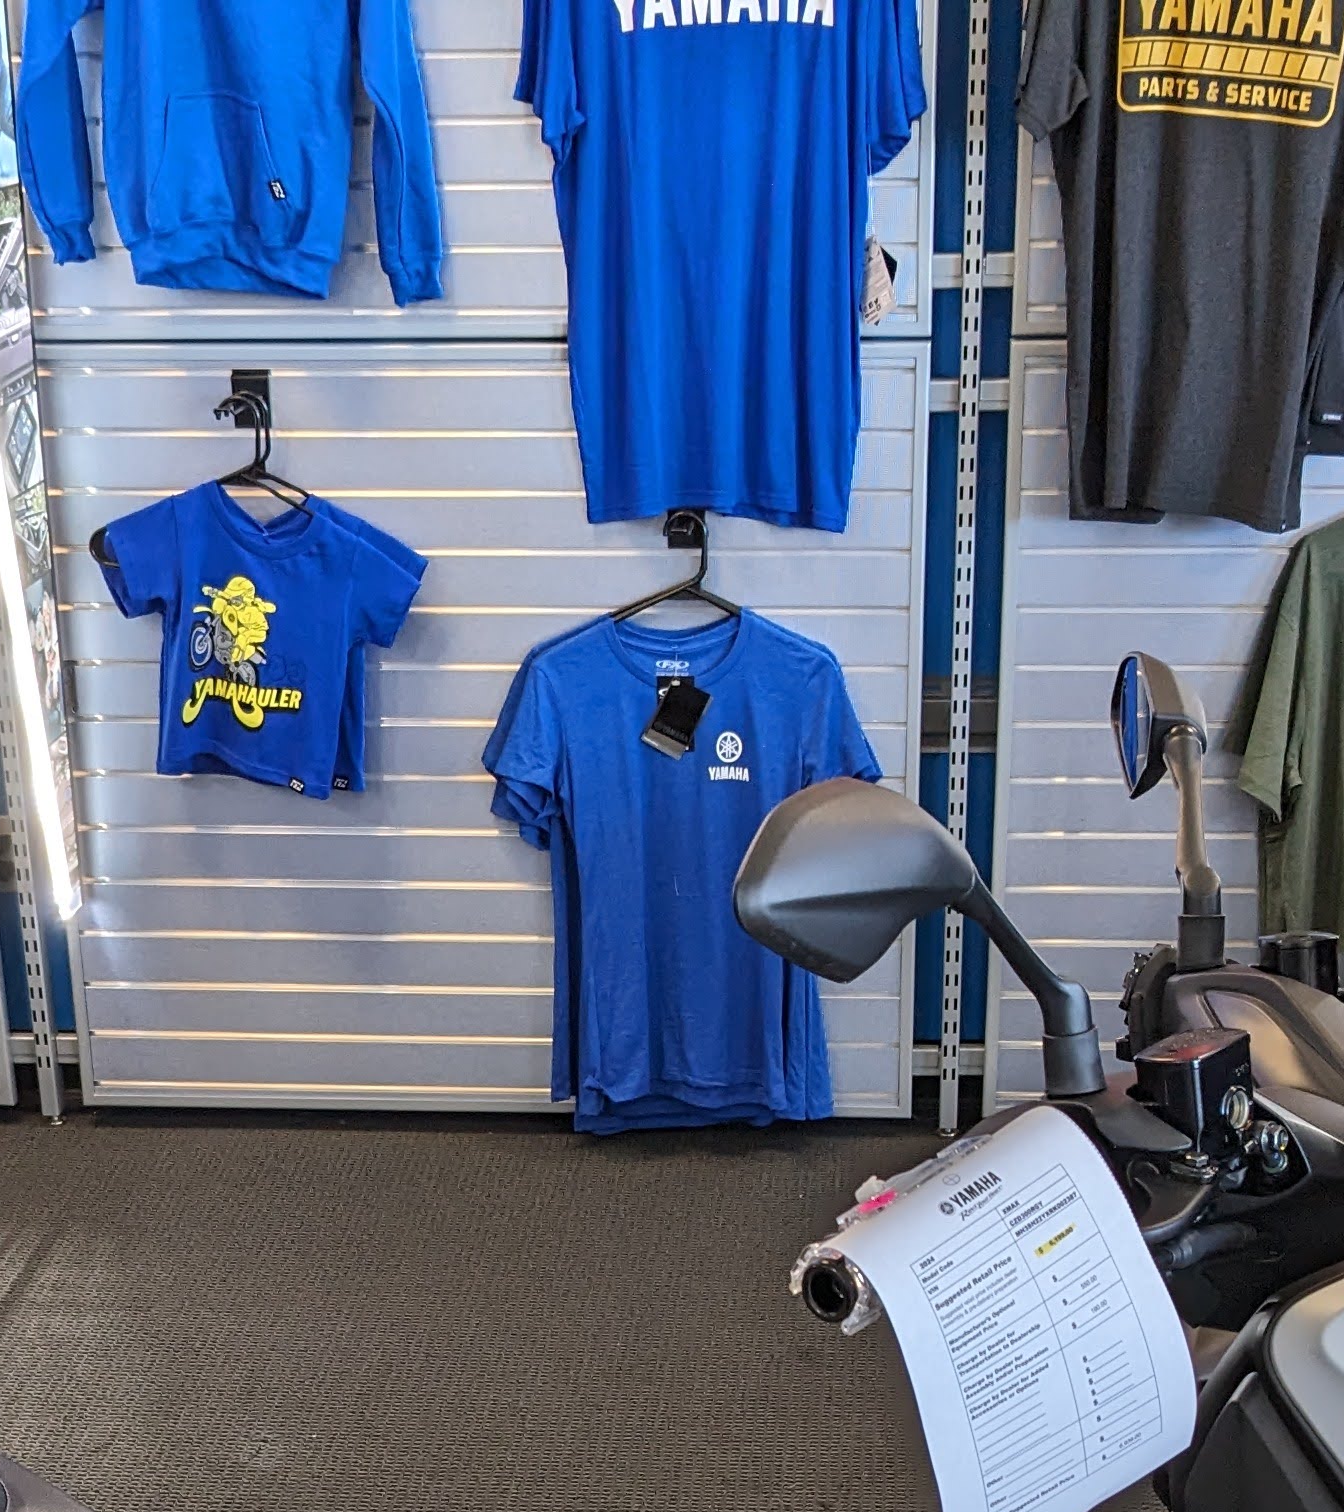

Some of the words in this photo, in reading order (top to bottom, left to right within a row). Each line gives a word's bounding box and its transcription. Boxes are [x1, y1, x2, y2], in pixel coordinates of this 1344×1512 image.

[1140, 0, 1332, 45] YAMAHA
[1139, 77, 1200, 100] PARTS
[1206, 81, 1219, 102] &
[1225, 83, 1312, 112] SERVICE
[708, 766, 750, 782] YAMAHA
[949, 1171, 1002, 1207] YAMAHA
[922, 1270, 939, 1284] Model
[939, 1260, 954, 1272] Code
[928, 1285, 939, 1296] VIN
[934, 1282, 972, 1311] Suggested
[972, 1268, 993, 1287] Retail
[993, 1256, 1012, 1271] Price
[949, 1316, 991, 1345] Manufacturer's
[992, 1299, 1016, 1318] Optional
[951, 1330, 982, 1353] Equipment
[983, 1321, 998, 1333] Price
[957, 1355, 978, 1370] Charge
[987, 1336, 1006, 1351] Dealer
[1007, 1330, 1015, 1338] for
[959, 1348, 1003, 1377] Transportation
[1010, 1323, 1041, 1345] Dealership
[964, 1378, 985, 1393] Charge
[994, 1360, 1014, 1374] Dealer
[1014, 1354, 1023, 1362] for
[966, 1380, 995, 1400] Assembly
[996, 1368, 1014, 1382] and/or
[1015, 1346, 1049, 1370] Preparation
[969, 1398, 991, 1414] Charge
[1000, 1381, 1020, 1396] Dealer
[1020, 1375, 1029, 1383] for
[1030, 1362, 1049, 1378] Added
[971, 1397, 1008, 1421] Accessories
[1016, 1377, 1039, 1394] Options
[1040, 1483, 1059, 1496] Retail
[1059, 1474, 1075, 1486] Price
